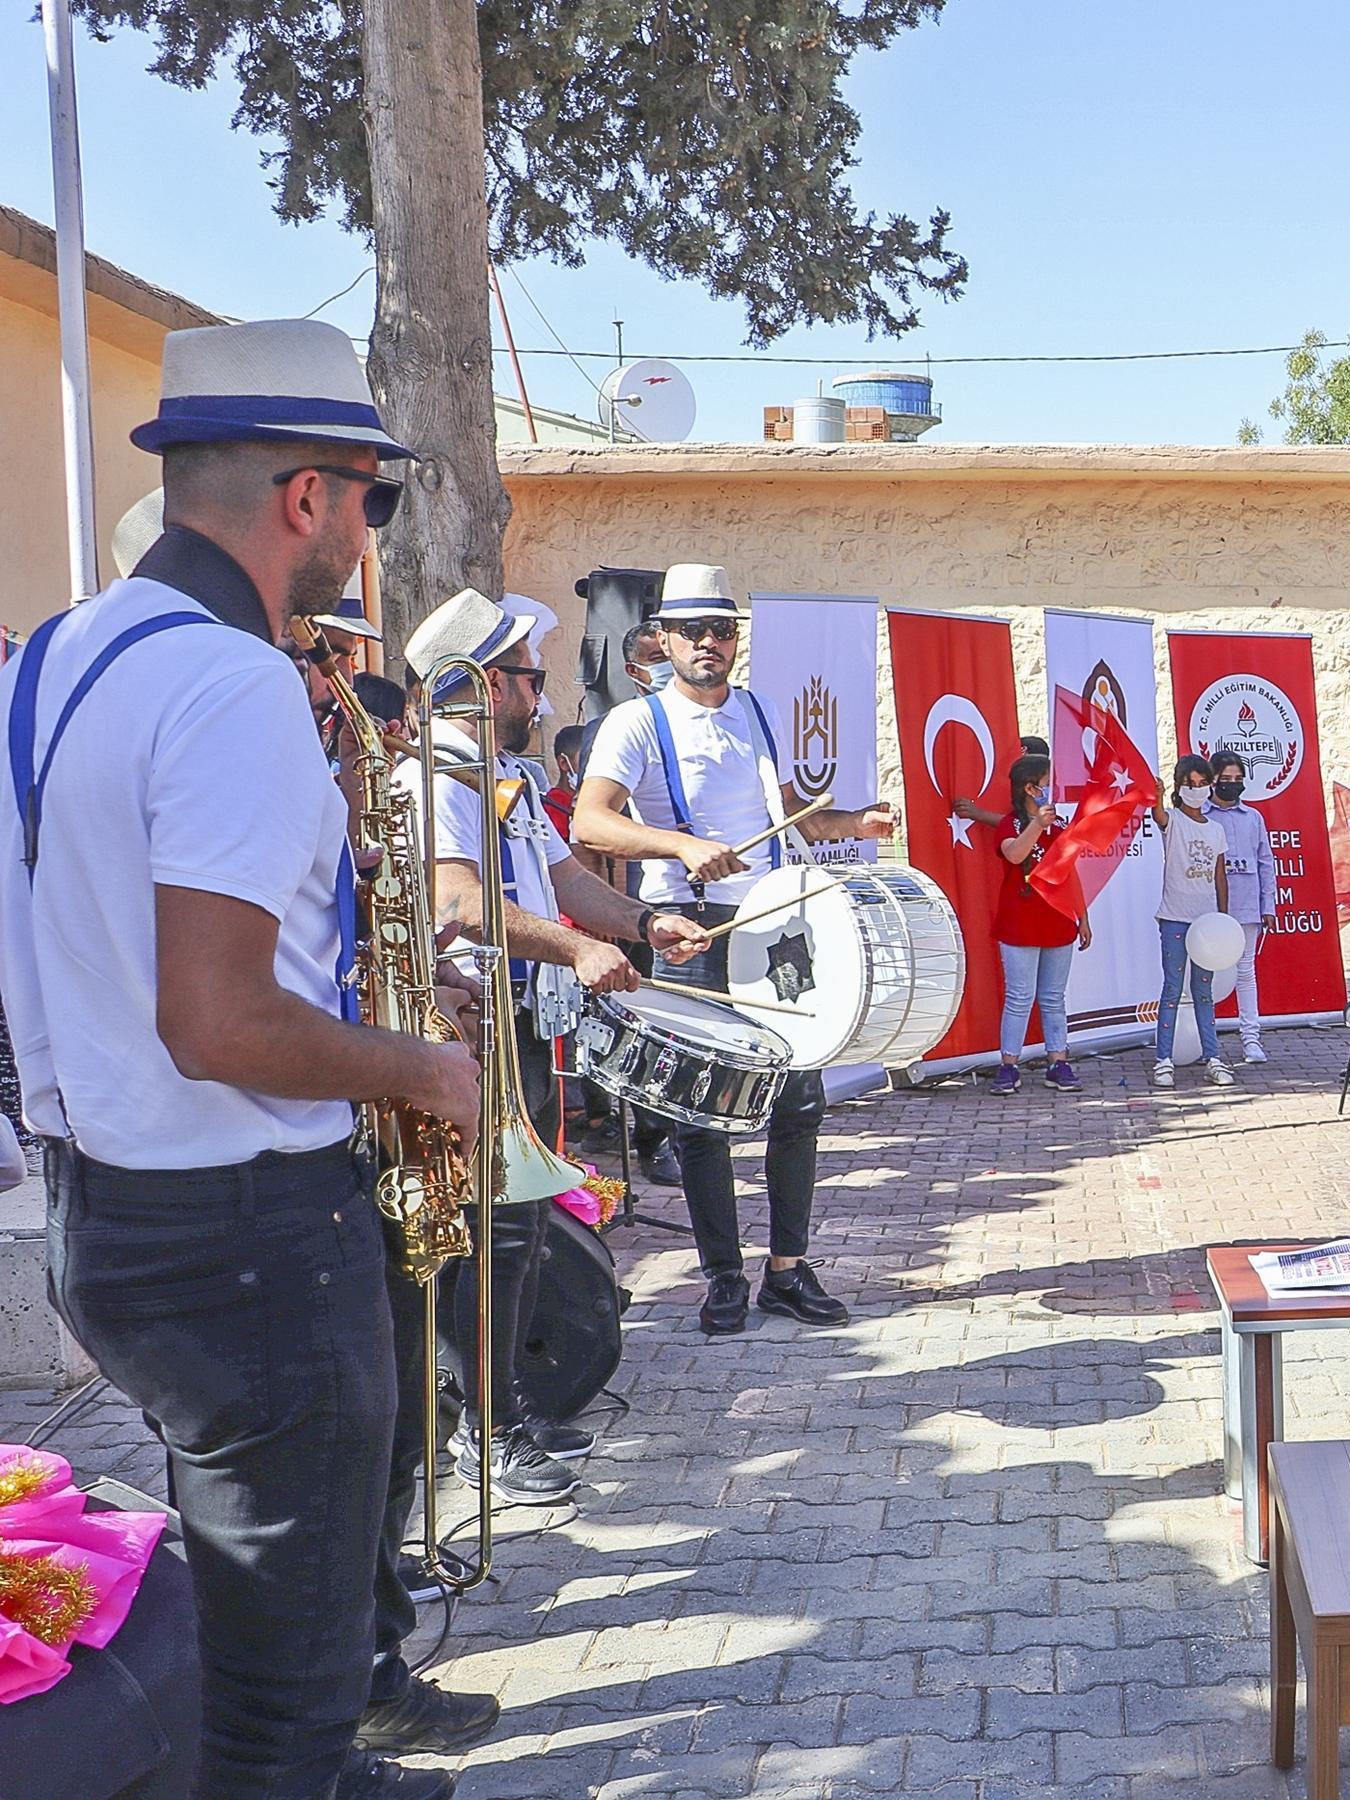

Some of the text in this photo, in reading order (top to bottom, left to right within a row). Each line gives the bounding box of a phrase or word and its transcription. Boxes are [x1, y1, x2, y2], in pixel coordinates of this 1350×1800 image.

[1204, 687, 1225, 714] MİLLİ
[1224, 681, 1257, 695] EĞİTİM
[1258, 687, 1293, 733] BAKANLIĞI
[1223, 741, 1275, 752] KIZILTEPE
